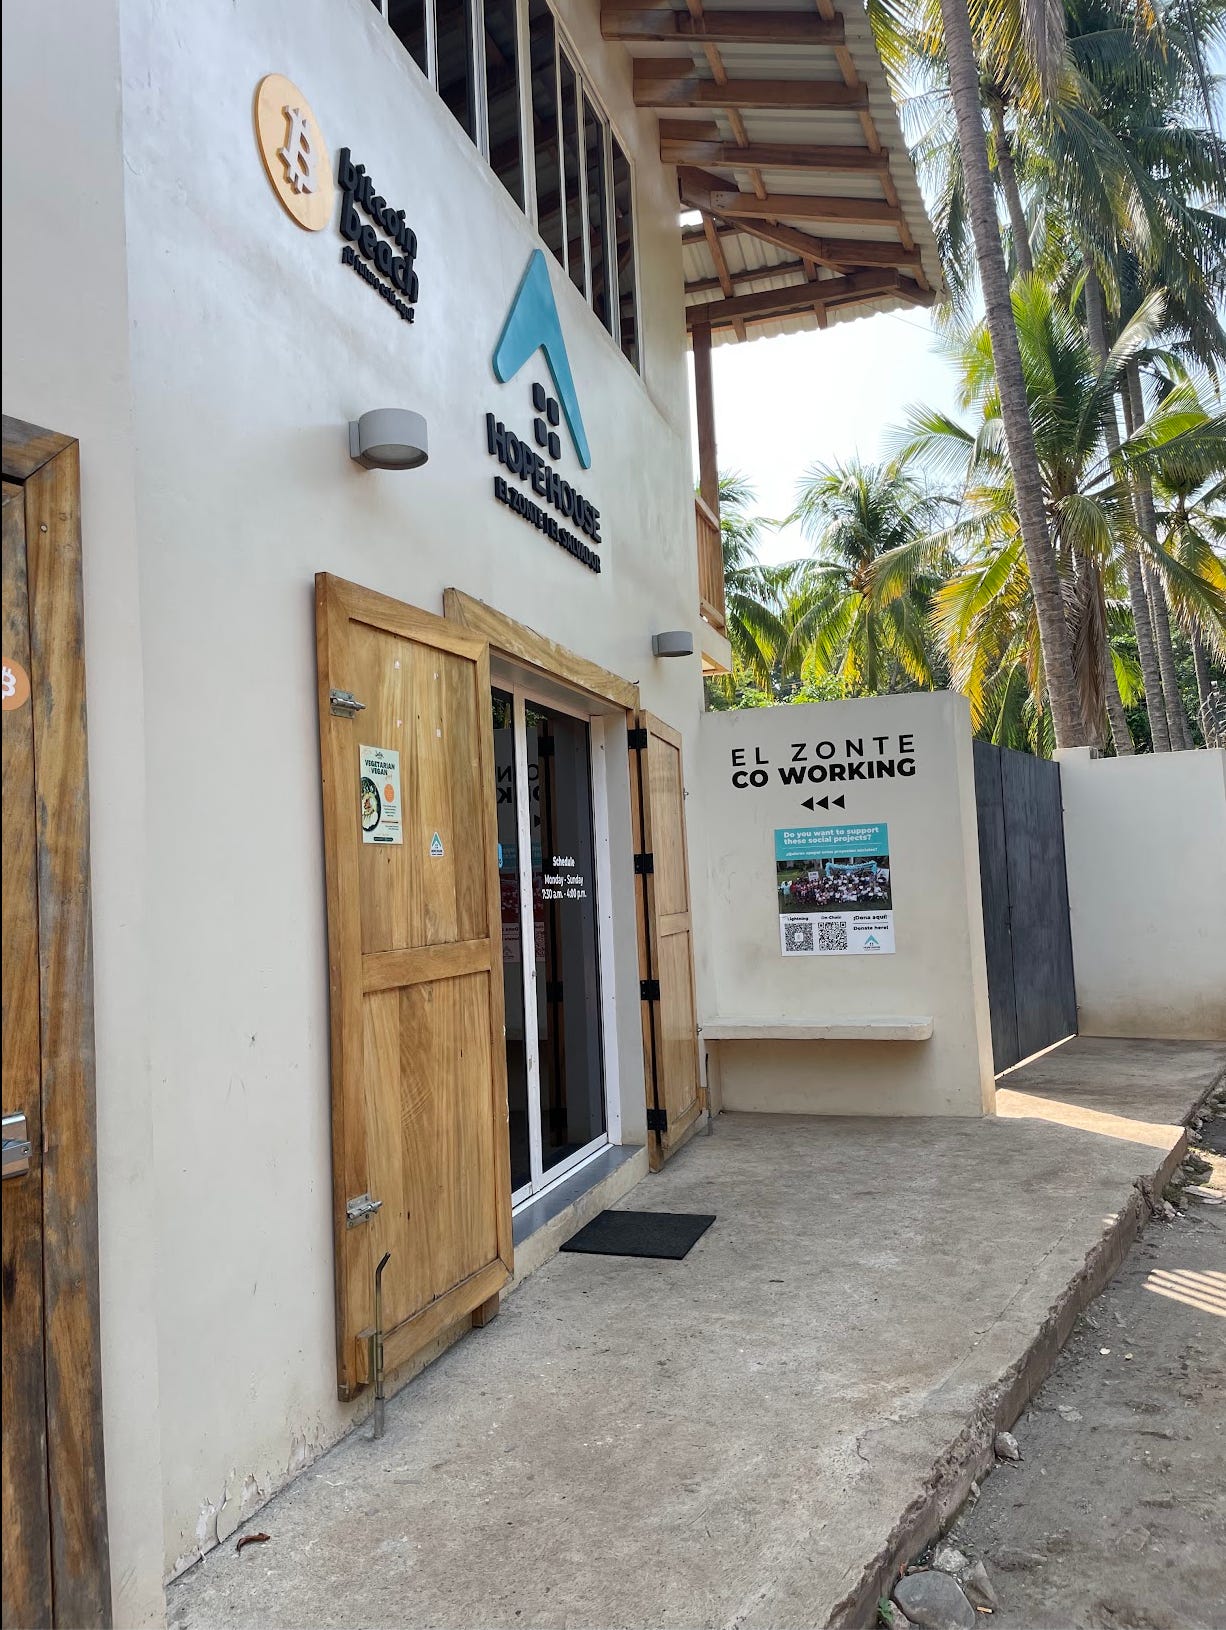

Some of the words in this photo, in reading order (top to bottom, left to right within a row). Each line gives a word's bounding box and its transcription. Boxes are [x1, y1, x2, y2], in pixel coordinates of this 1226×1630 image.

[338, 147, 418, 259] bitcoin
[340, 190, 419, 303] beach
[486, 413, 546, 497] HOPE
[545, 466, 602, 543] HOUSE
[494, 476, 510, 505] EL
[508, 487, 543, 530] ZONTE
[547, 517, 560, 542] EL
[559, 528, 601, 573] SALVADOR
[731, 747, 769, 767] EL
[791, 734, 915, 762] ZONTE
[364, 759, 395, 770] VEGETARIAN
[370, 767, 388, 776] VEGAN
[731, 769, 769, 789] CO
[778, 758, 916, 785] WORKING
[783, 837, 806, 845] these
[808, 835, 832, 843] social
[833, 834, 872, 843] projects?
[796, 831, 812, 840] you
[813, 829, 834, 837] want
[846, 826, 879, 836] support
[552, 855, 575, 867] Schedule
[544, 873, 564, 887] Monday
[566, 873, 584, 887] Sunday
[553, 890, 563, 899] a.m.
[576, 889, 587, 900] p.m.
[872, 913, 888, 921] aquí!
